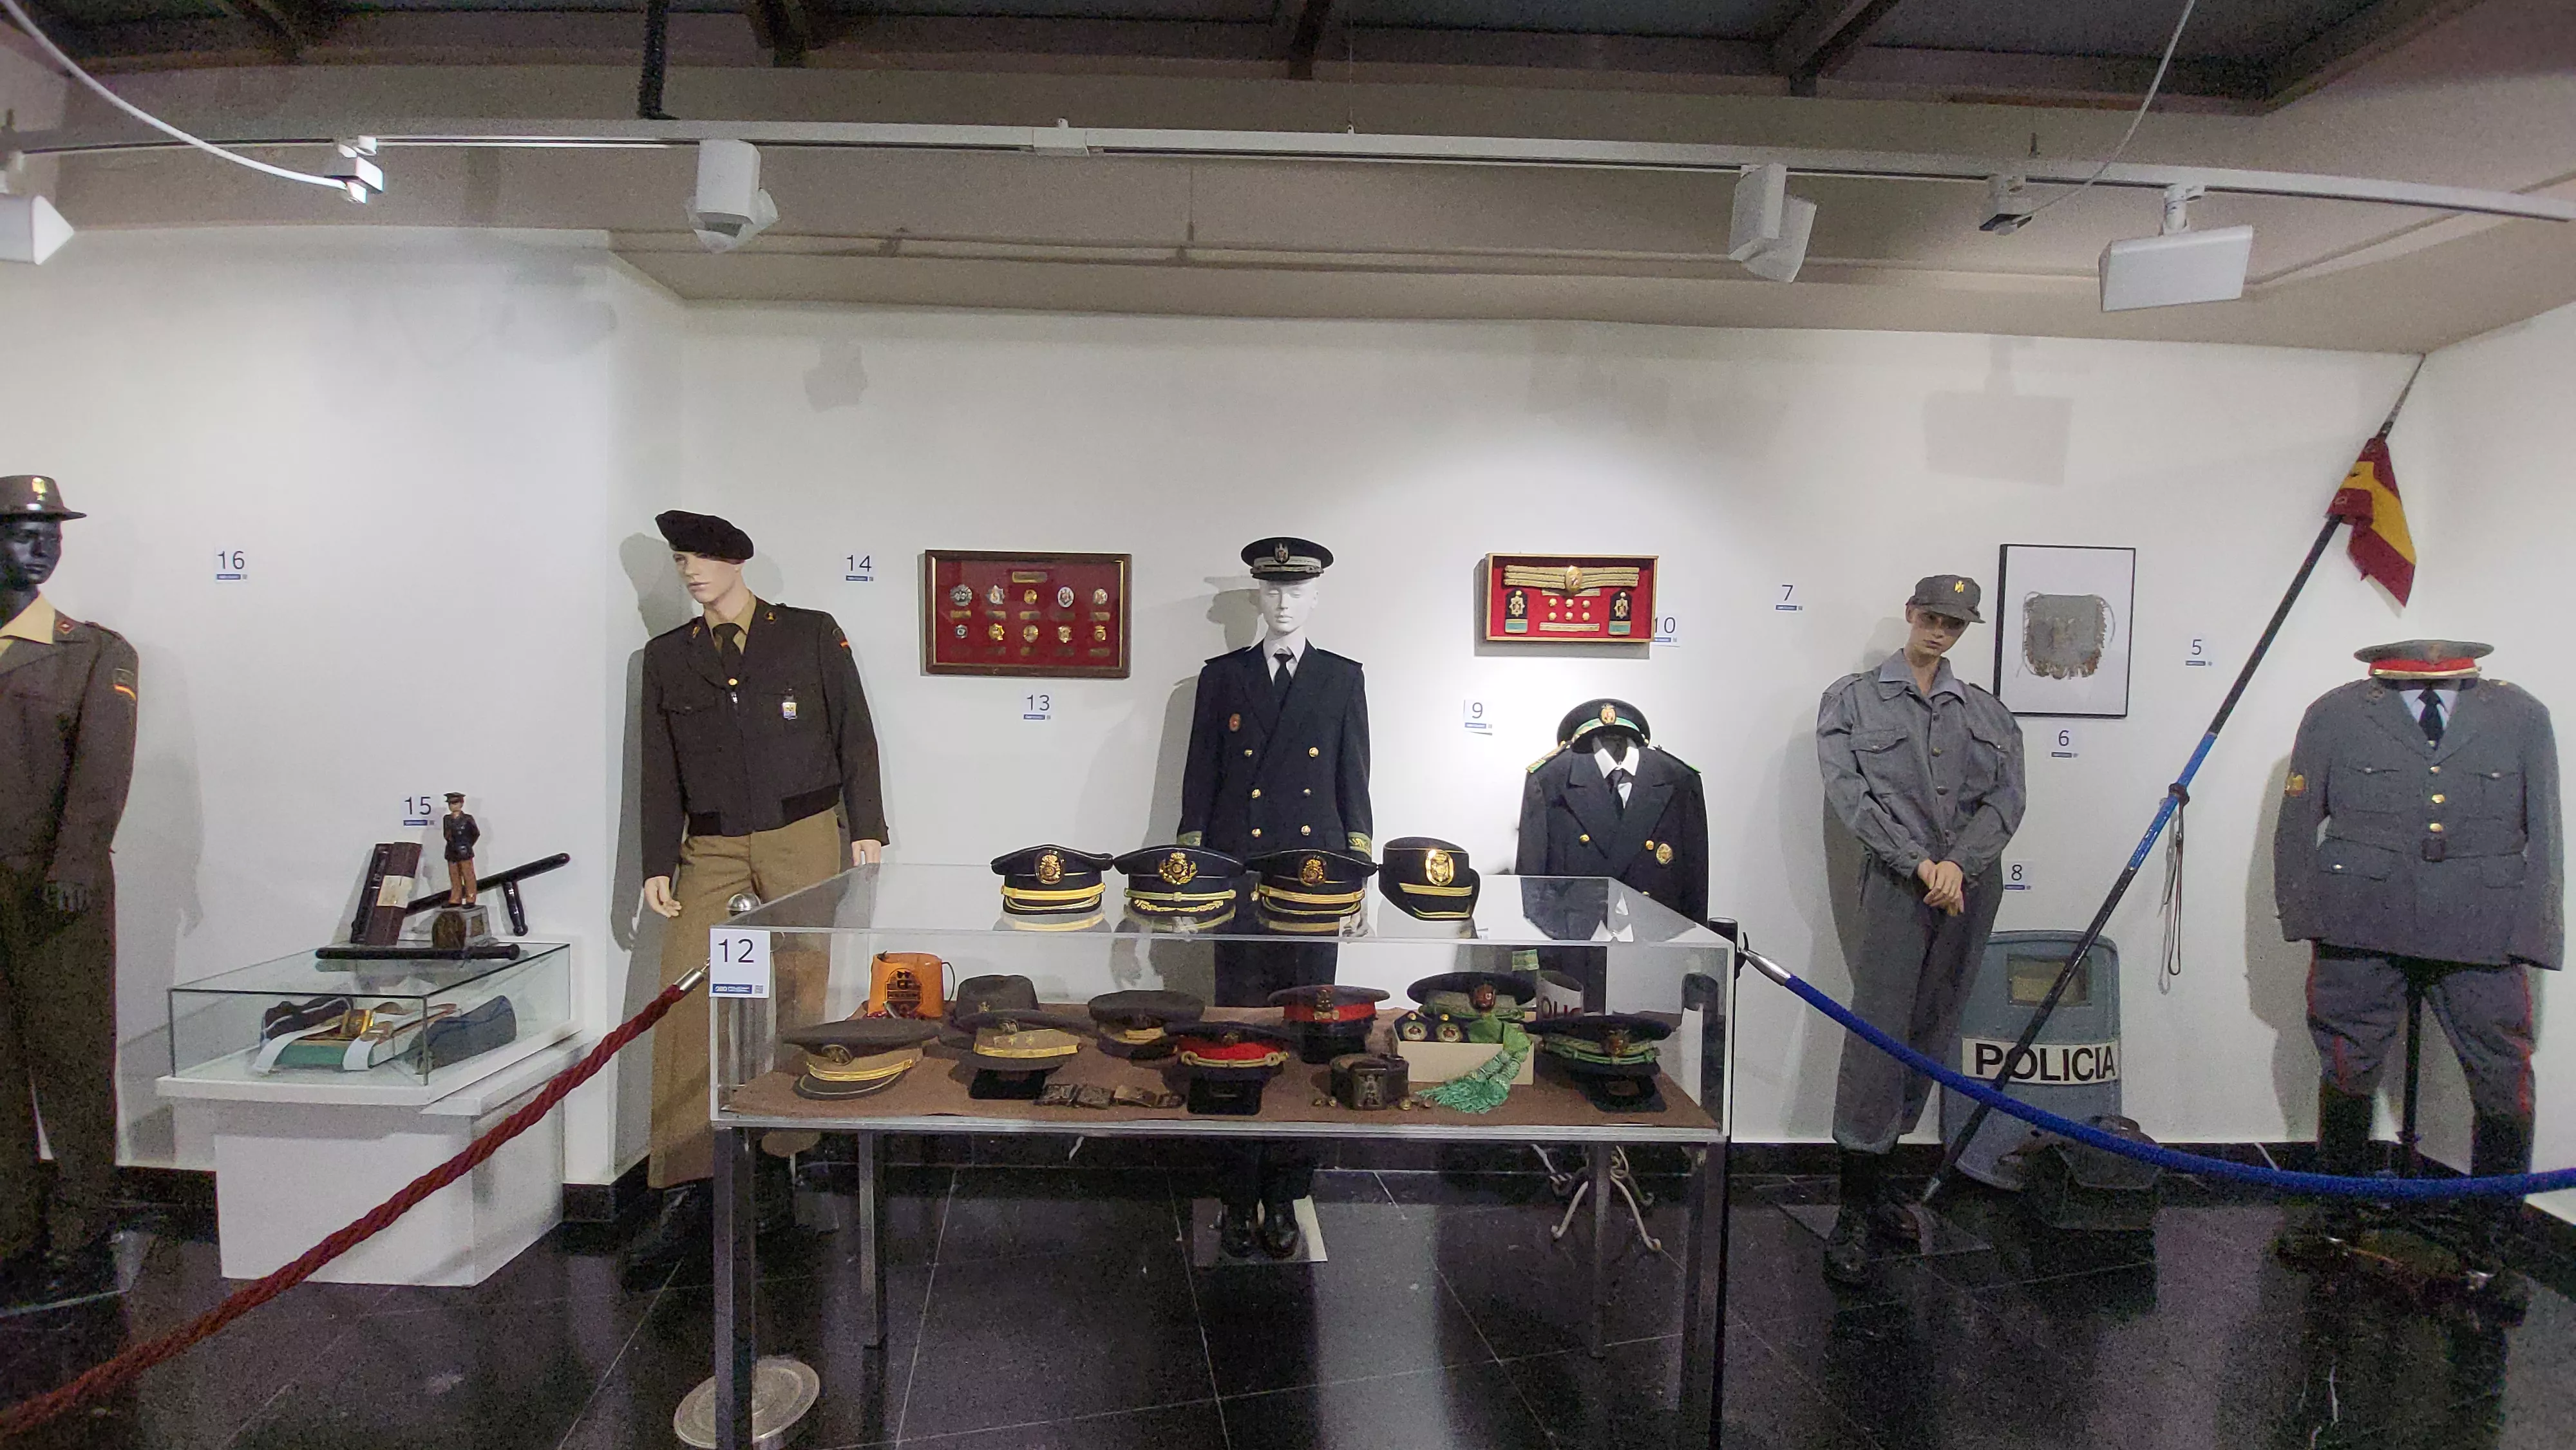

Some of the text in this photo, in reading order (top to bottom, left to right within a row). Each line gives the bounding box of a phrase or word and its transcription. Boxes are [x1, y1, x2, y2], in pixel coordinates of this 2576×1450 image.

[218, 551, 245, 570] 16
[846, 554, 872, 572] 14
[1782, 584, 1794, 601] 7
[1655, 617, 1676, 634] 10
[2192, 639, 2202, 655] 5
[1027, 694, 1050, 711] 13
[1472, 702, 1483, 719] 9
[2058, 730, 2069, 747] 6
[404, 796, 431, 815] 15
[2011, 864, 2023, 881] 8
[718, 938, 754, 963] 12
[1975, 1042, 2116, 1082] POLICIA
